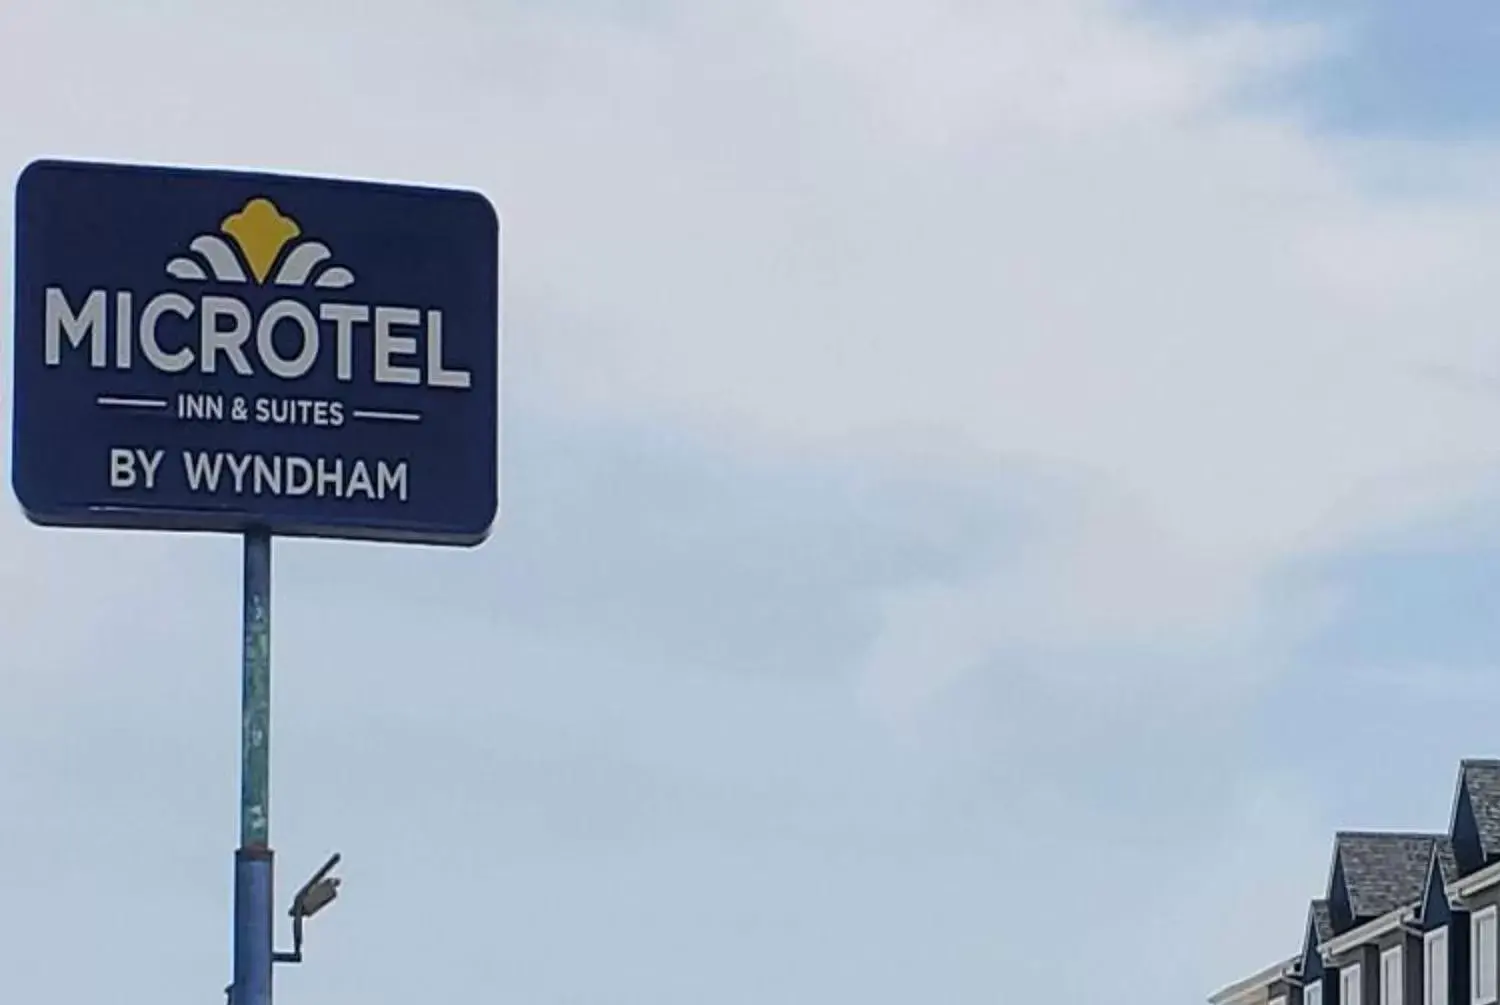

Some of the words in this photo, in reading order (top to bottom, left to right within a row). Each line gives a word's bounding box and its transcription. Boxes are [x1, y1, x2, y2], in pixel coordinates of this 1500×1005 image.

[44, 288, 471, 387] MICROTEL
[178, 394, 223, 420] INN
[231, 399, 248, 421] &
[255, 399, 344, 426] SUITES
[110, 448, 165, 488] BY
[183, 452, 408, 501] WYNDHAM
